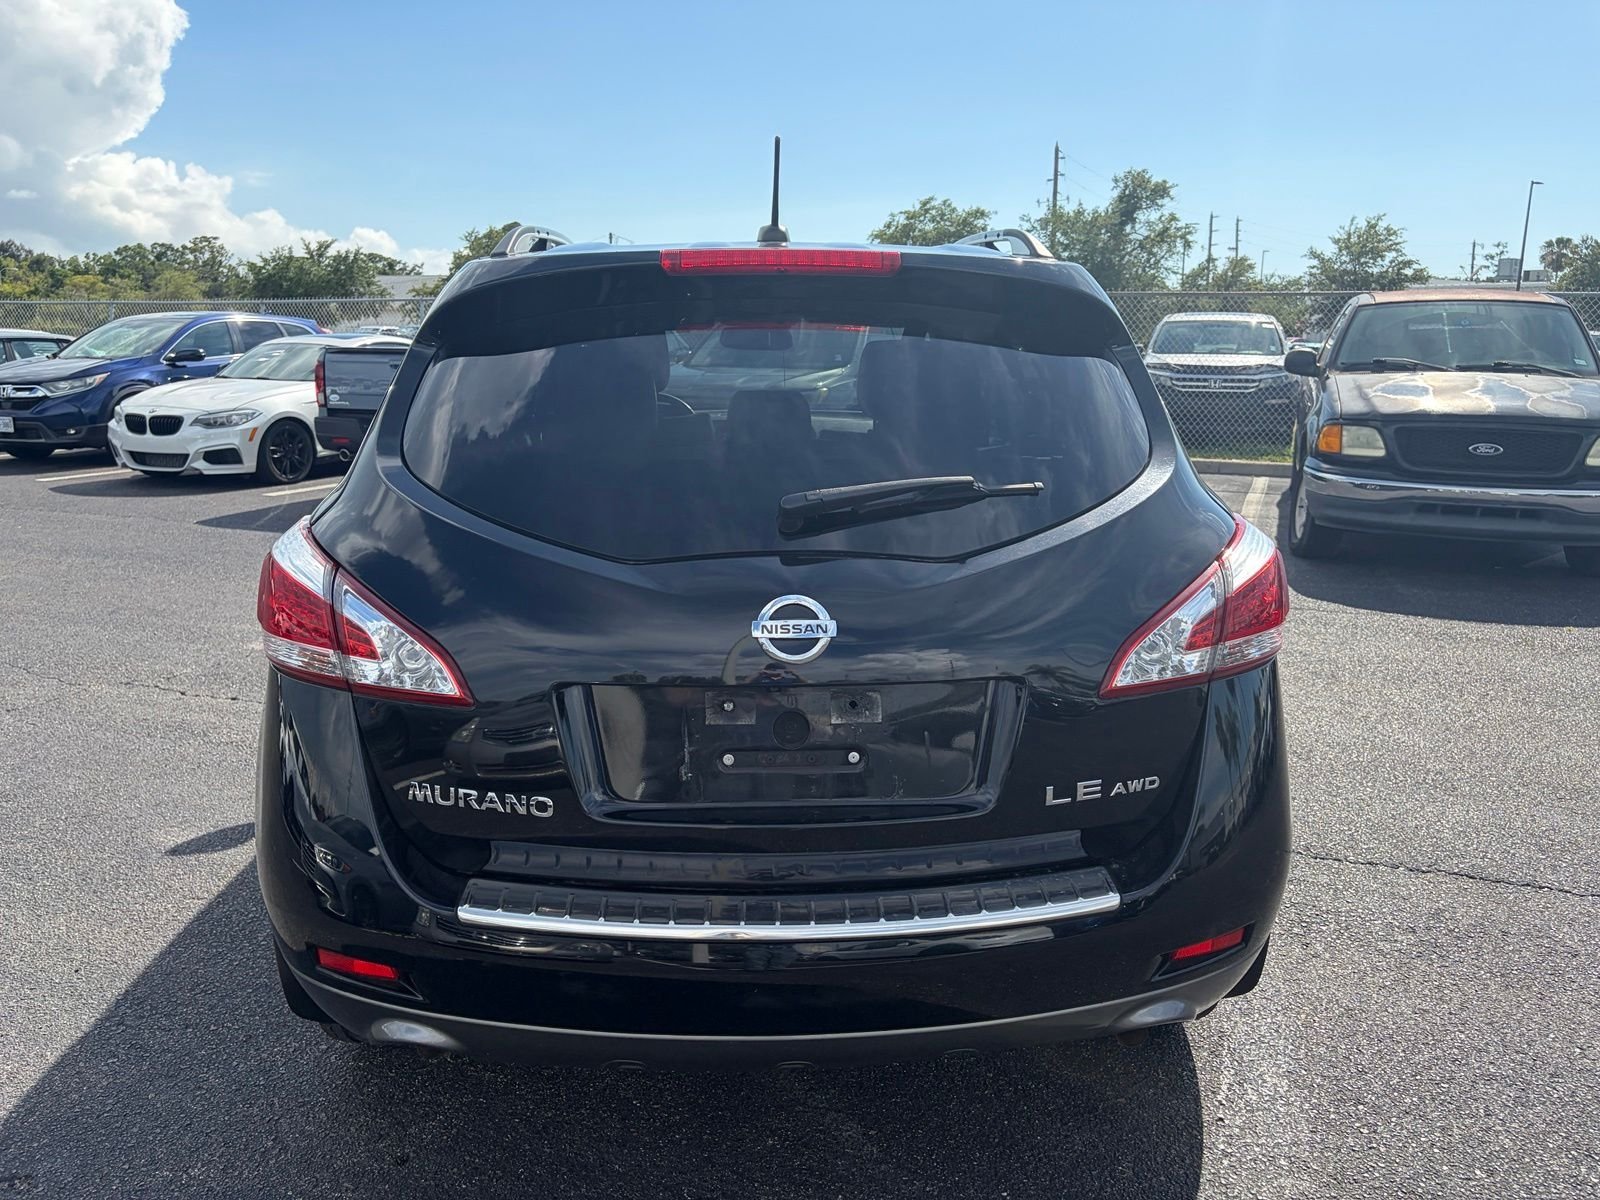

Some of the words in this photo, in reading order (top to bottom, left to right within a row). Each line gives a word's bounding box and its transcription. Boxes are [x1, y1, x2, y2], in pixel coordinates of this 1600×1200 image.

[761, 623, 828, 635] NISSAN
[407, 781, 554, 818] MURANO
[1045, 779, 1102, 806] LE
[1109, 776, 1160, 797] AWD
